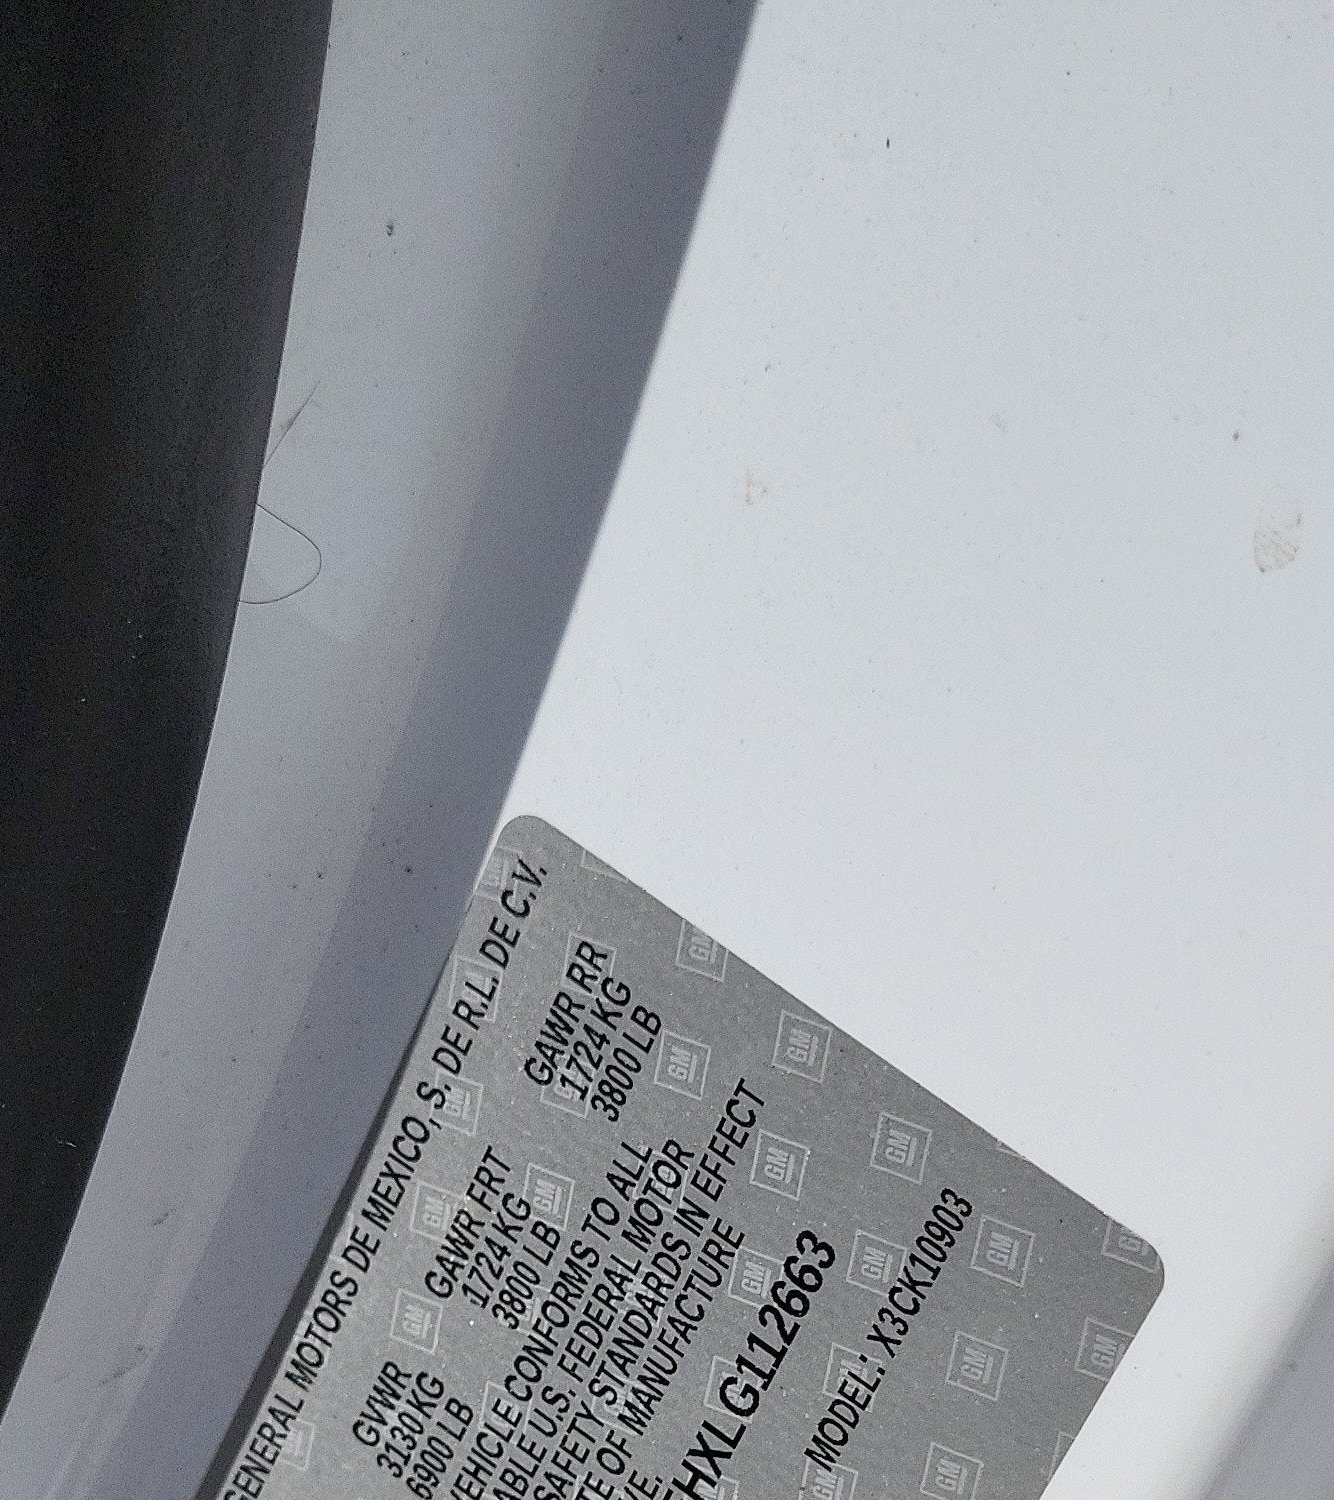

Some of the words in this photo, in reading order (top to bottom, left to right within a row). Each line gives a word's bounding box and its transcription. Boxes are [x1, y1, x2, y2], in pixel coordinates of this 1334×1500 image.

[479, 916, 521, 969] DE
[500, 858, 548, 919] C.V.
[431, 1024, 473, 1075] DE
[452, 976, 500, 1031] R.L.
[523, 991, 586, 1086] GAWR
[565, 940, 609, 994] RR
[559, 1022, 611, 1102] 1724
[590, 976, 631, 1033] KG
[416, 1081, 452, 1110] S.
[590, 1047, 642, 1123] 3800
[622, 1005, 662, 1055] LB
[361, 1115, 442, 1232] MEXICO,
[690, 1077, 765, 1203] EFFECT
[341, 1225, 381, 1273] DE
[424, 1209, 486, 1299] GAWR
[466, 1145, 511, 1213] FRT
[461, 1236, 512, 1310] 1724
[490, 1192, 532, 1245] KG
[491, 1260, 542, 1330] 3800
[522, 1220, 561, 1267] LB
[504, 1239, 600, 1402] CONFORMS
[581, 1196, 621, 1242] TO
[606, 1141, 653, 1203] ALL
[672, 1195, 711, 1238] IN
[284, 1269, 359, 1392] MOTORS
[528, 1385, 577, 1438] U.S.
[557, 1253, 642, 1384] FEDERAL
[621, 1139, 695, 1254] MOTOR
[587, 1231, 692, 1406] STANDARDS
[595, 1429, 632, 1476] OF
[617, 1217, 745, 1436] MANUFACTURE
[806, 1354, 886, 1473] MODEL:
[866, 1188, 973, 1360] X3CK10903
[351, 1361, 413, 1447] GVWR
[375, 1411, 425, 1479] 3130
[405, 1371, 445, 1420] KG
[405, 1435, 454, 1500] 6900
[435, 1397, 474, 1442] LB
